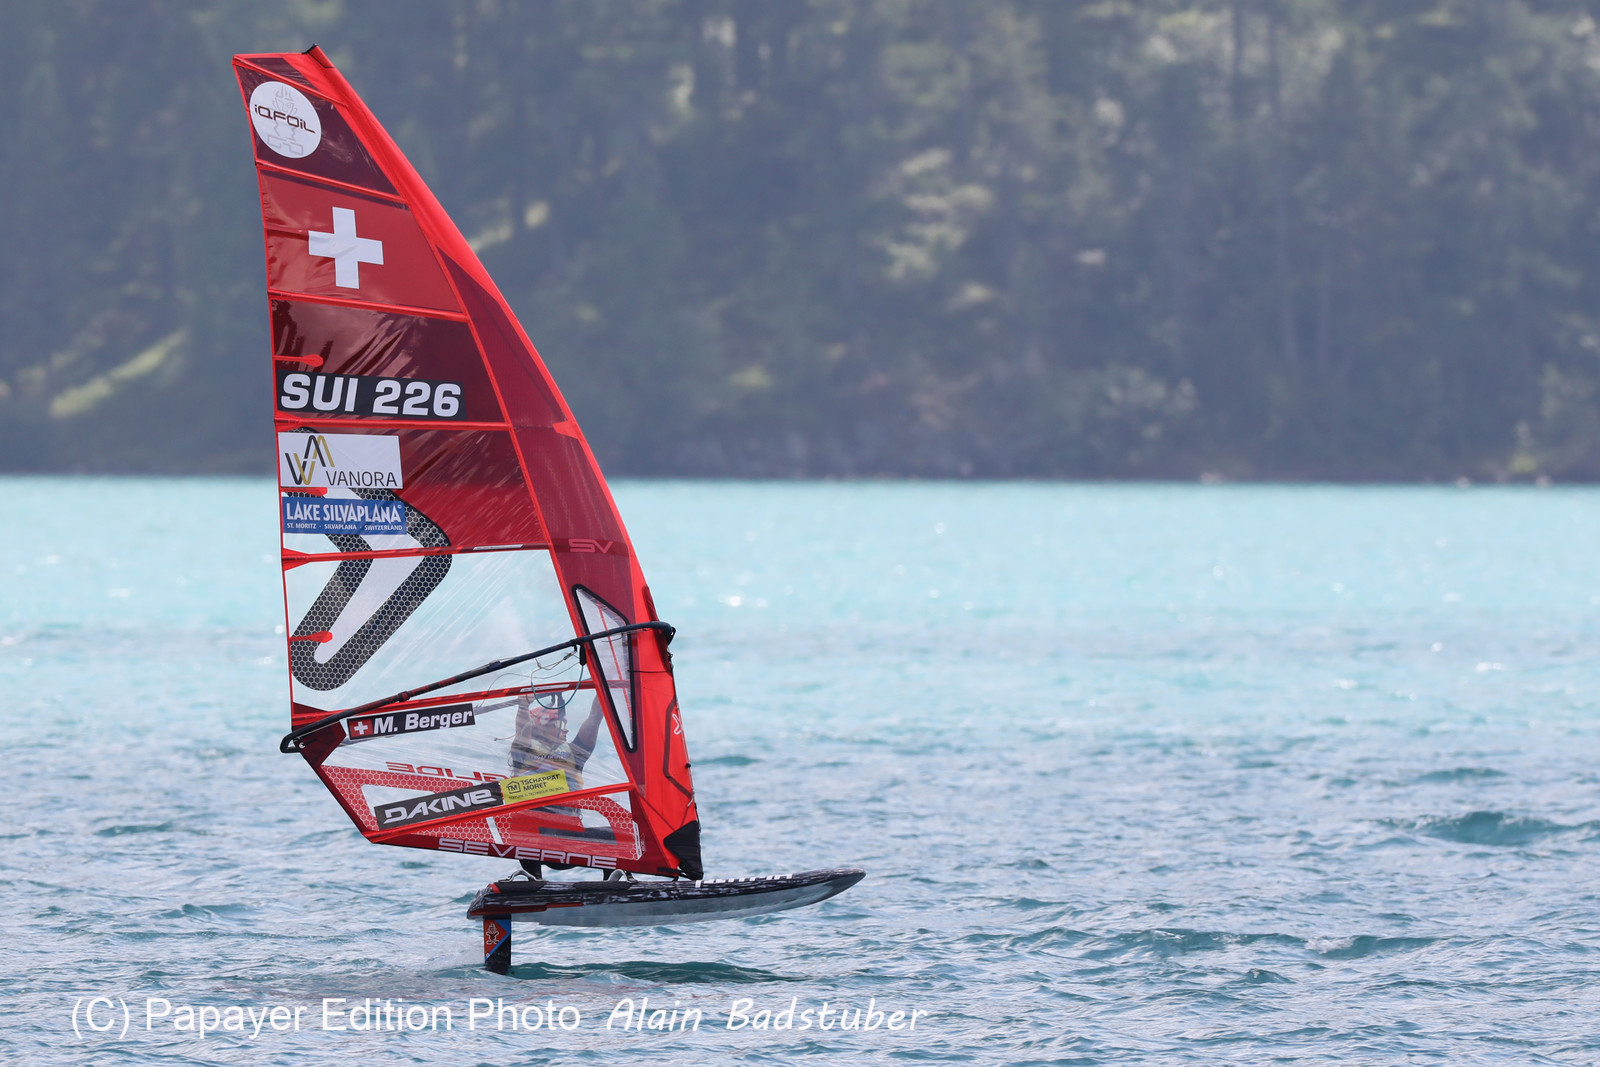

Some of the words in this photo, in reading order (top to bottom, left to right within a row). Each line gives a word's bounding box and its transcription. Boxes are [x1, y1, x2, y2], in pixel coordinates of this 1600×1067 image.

[280, 373, 359, 412] SUI
[372, 379, 462, 417] 226
[325, 470, 398, 487] VANORA
[286, 501, 320, 521] LAKE
[323, 503, 402, 524] SILVAPLANA
[373, 716, 398, 735] M.
[404, 709, 473, 730] Berger
[521, 774, 560, 785] TSCHAPPAT
[523, 782, 547, 791] MORET
[383, 788, 497, 825] DAKINE
[438, 837, 618, 870] SEVERNE
